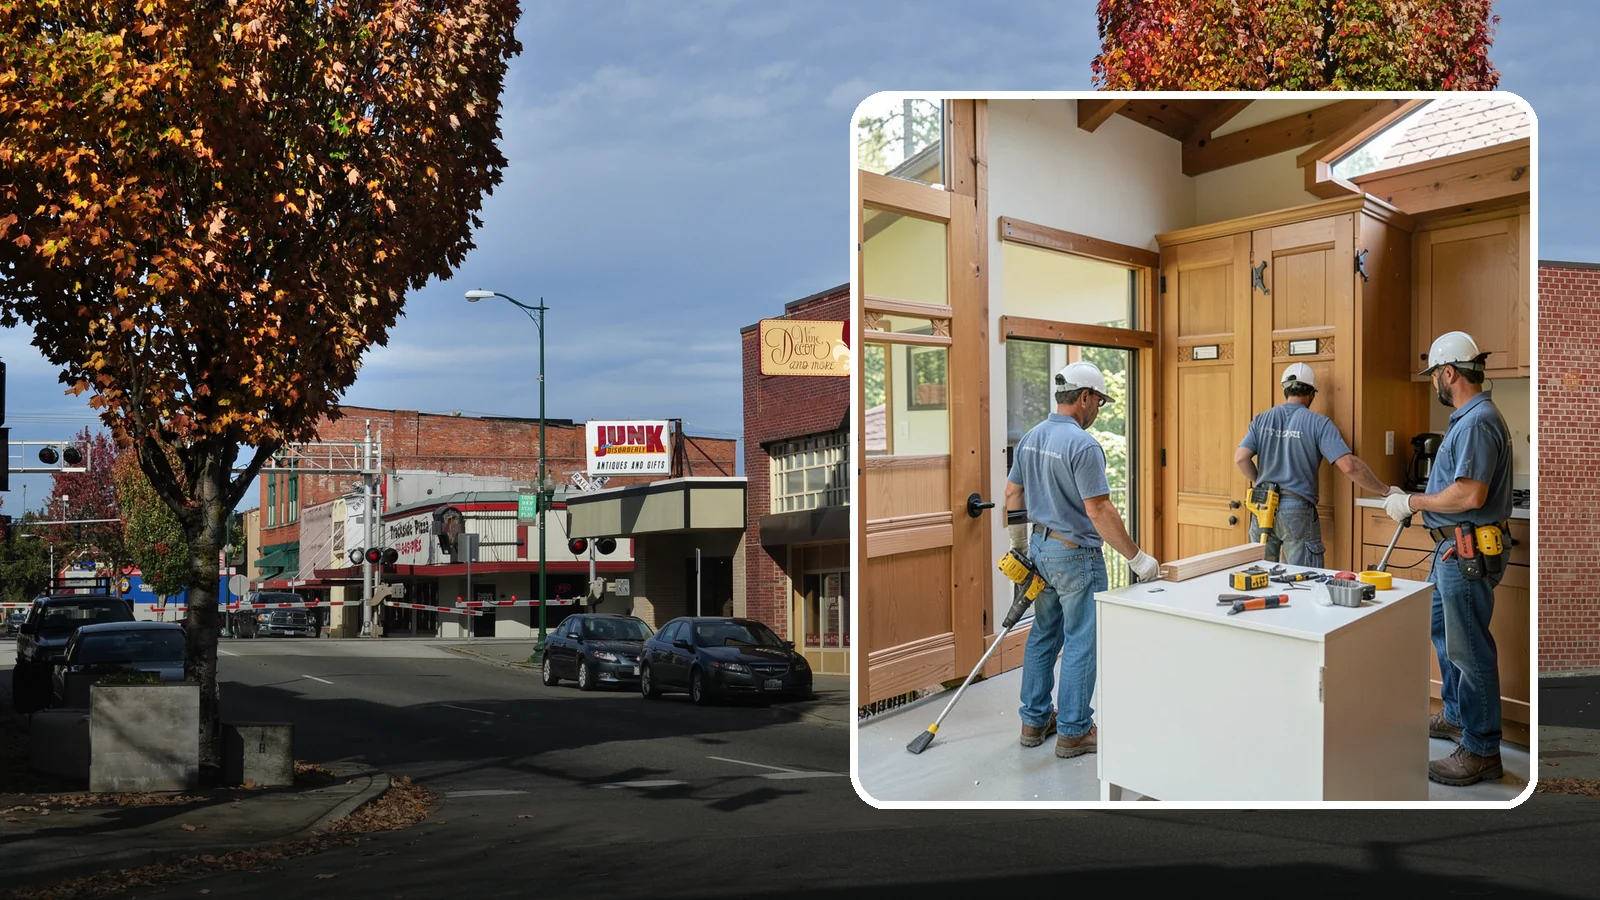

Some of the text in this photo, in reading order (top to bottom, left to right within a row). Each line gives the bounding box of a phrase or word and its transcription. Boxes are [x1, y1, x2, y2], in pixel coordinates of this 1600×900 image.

[595, 425, 665, 457] JUNK
[607, 446, 645, 454] DISORDERLY
[597, 460, 665, 470] ANTIQUES AND GIFTS
[390, 519, 429, 539] Trackside Pizza
